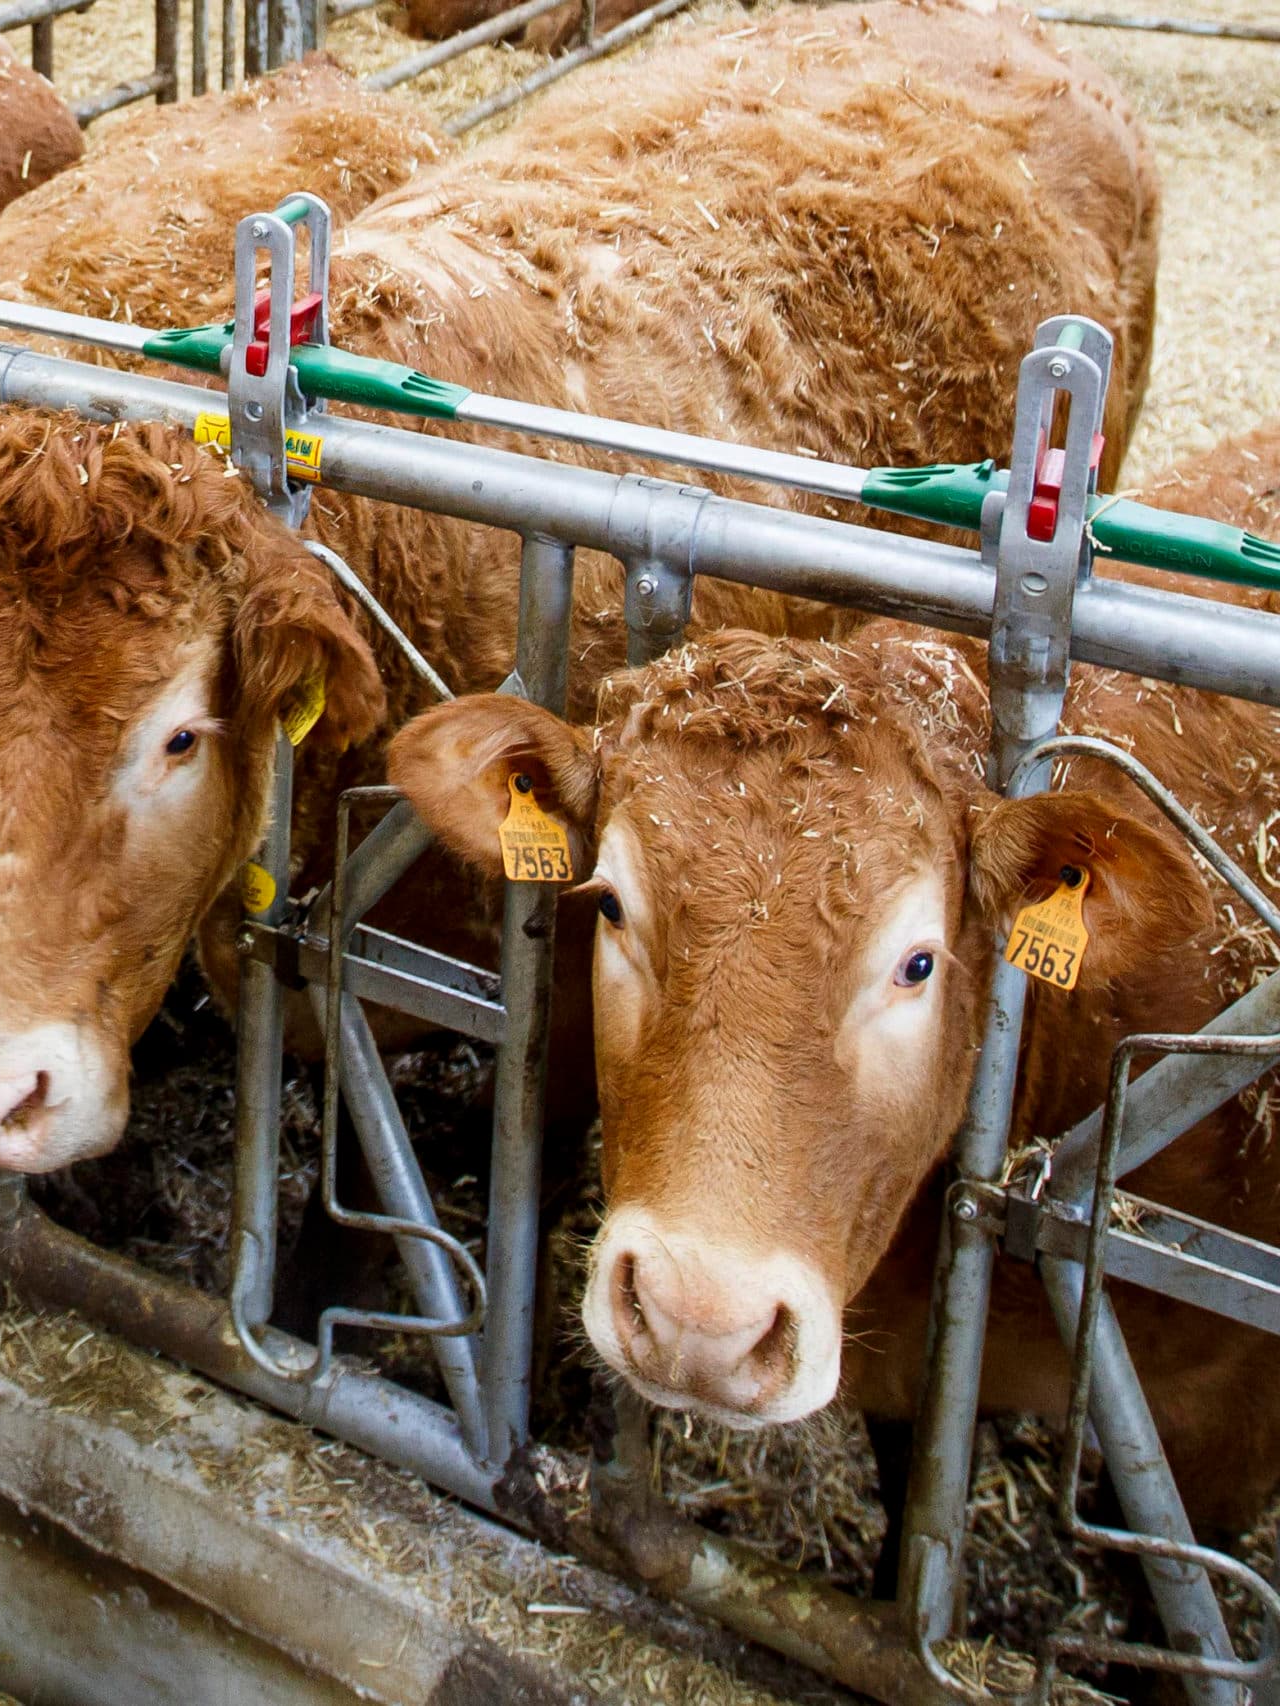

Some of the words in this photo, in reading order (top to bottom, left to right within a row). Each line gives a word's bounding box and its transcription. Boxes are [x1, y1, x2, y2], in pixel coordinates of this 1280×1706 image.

[1119, 538, 1213, 569] JOURDAIN
[507, 847, 569, 879] 7563
[1010, 928, 1077, 986] 7563
